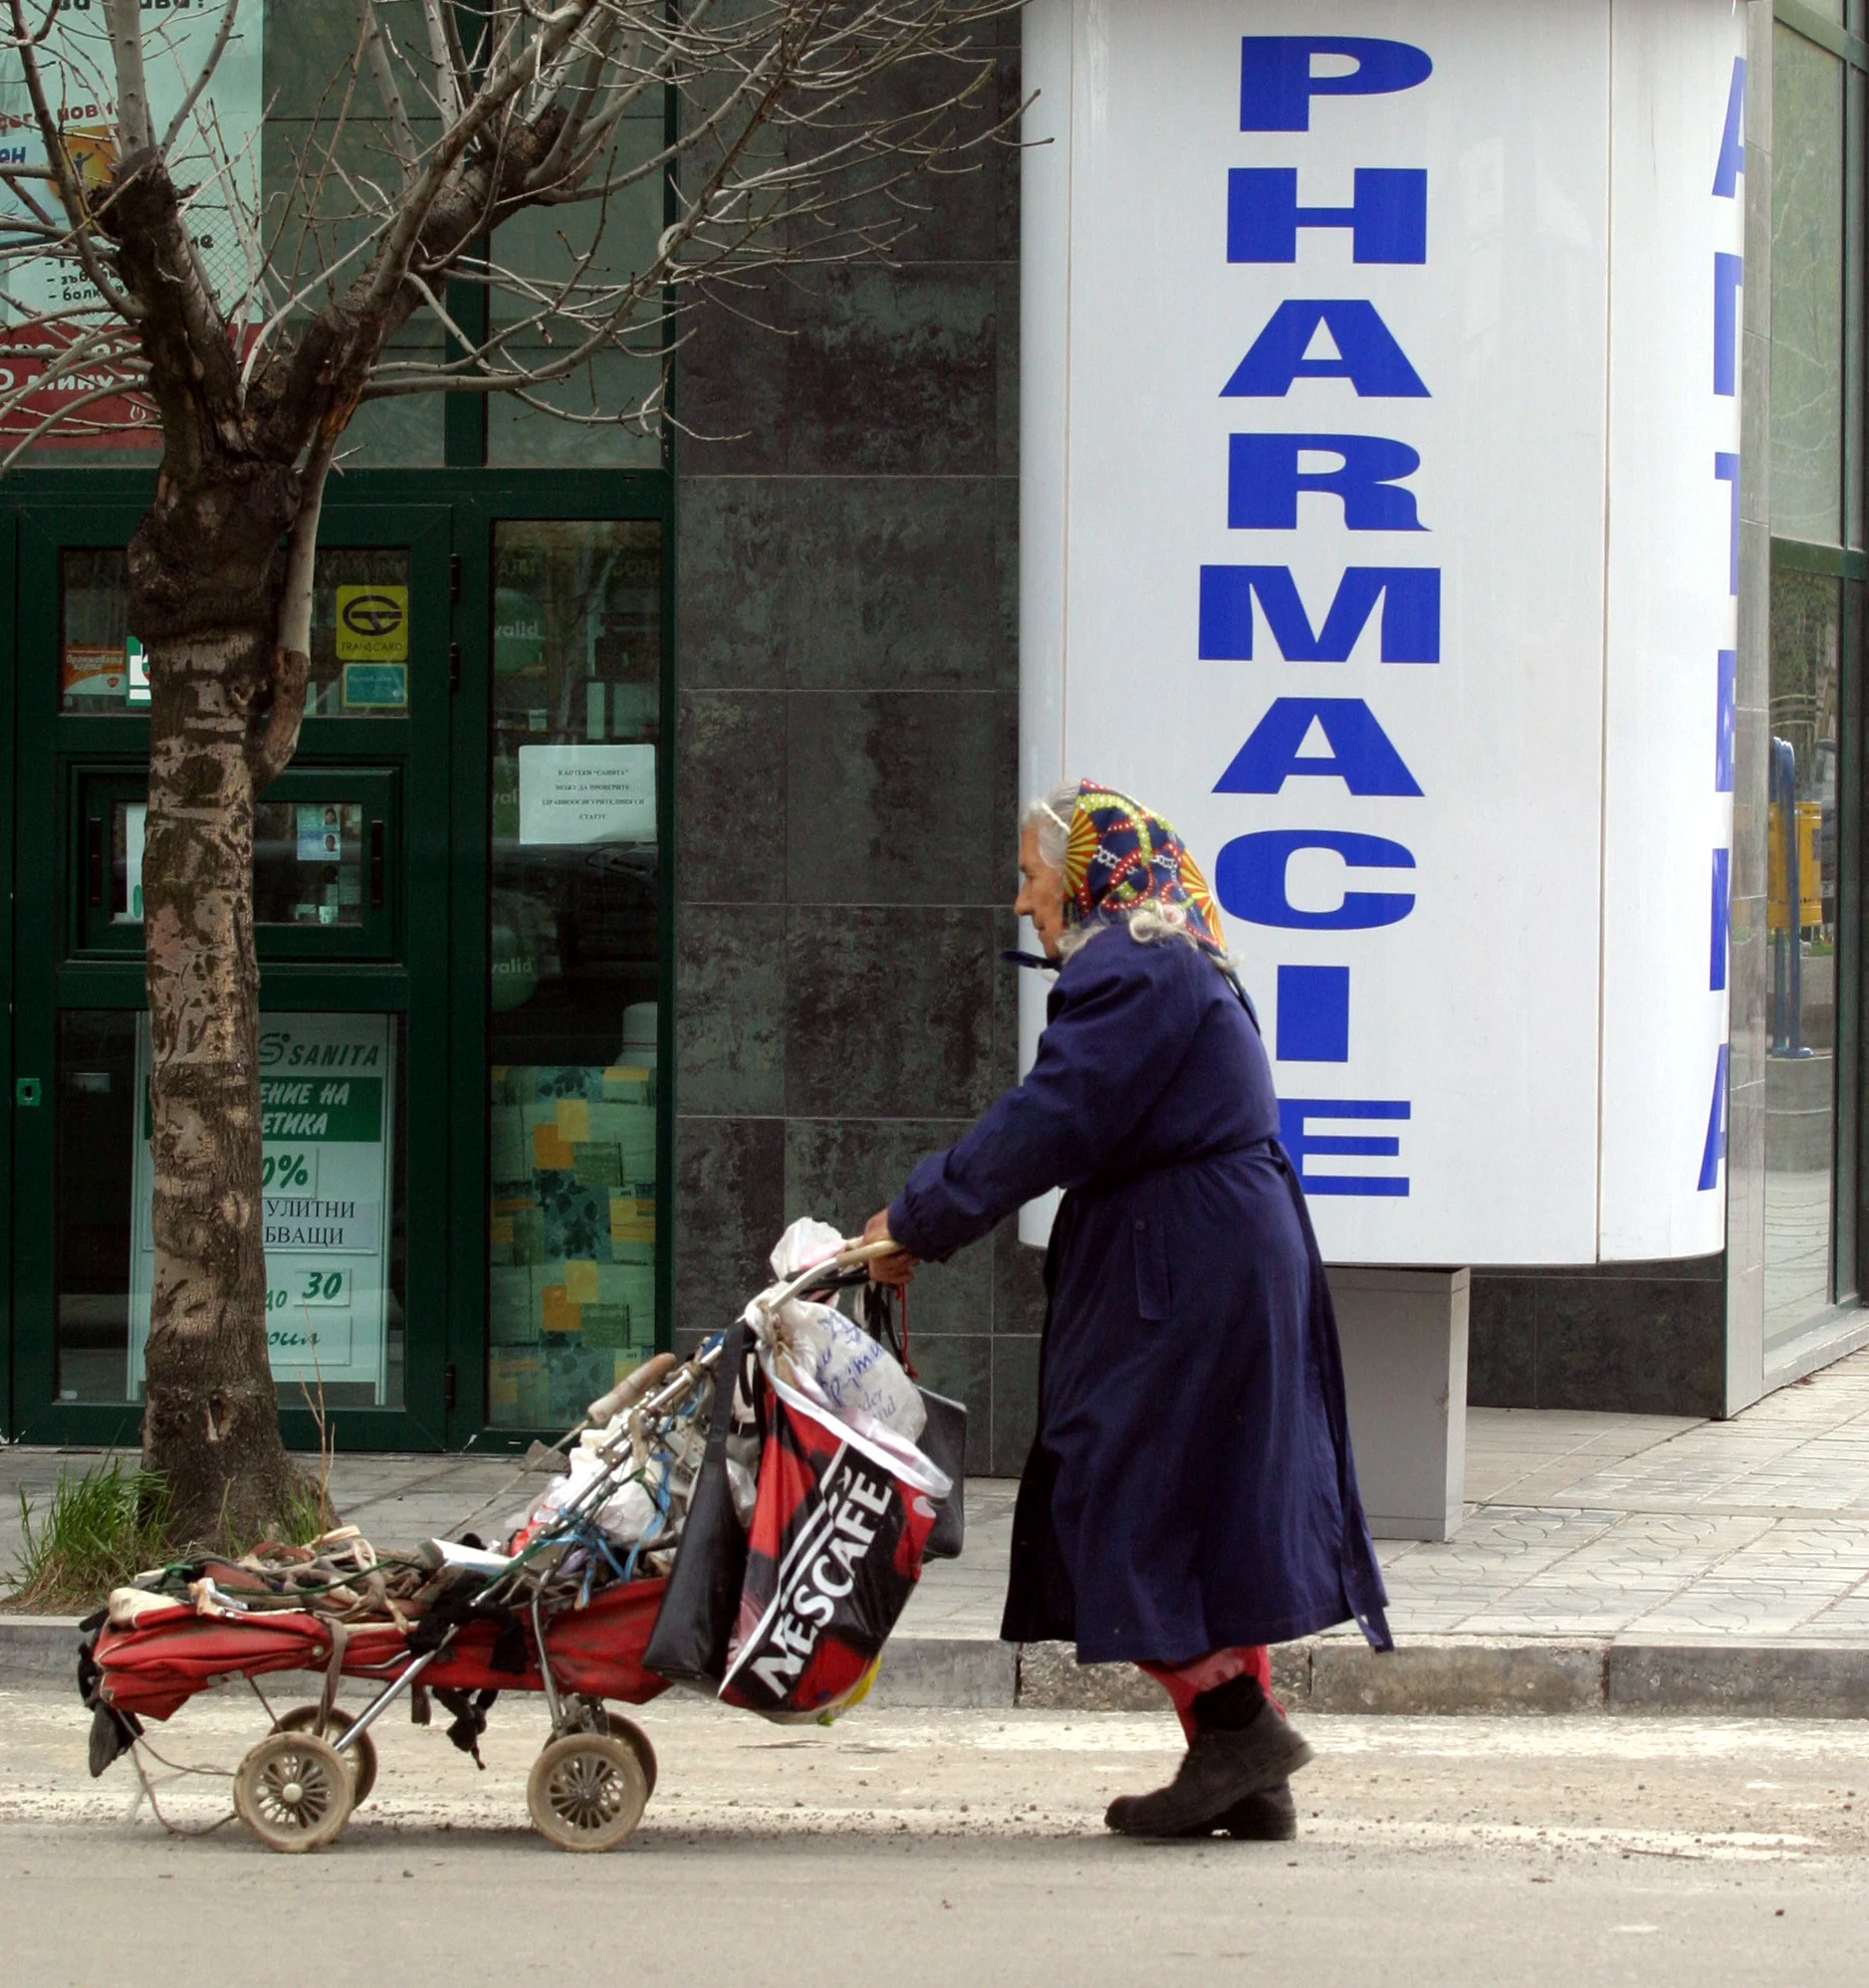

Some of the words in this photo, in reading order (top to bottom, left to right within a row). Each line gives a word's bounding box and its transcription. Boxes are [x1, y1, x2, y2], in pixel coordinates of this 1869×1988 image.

[1200, 37, 1441, 1196] PHARMACIE
[342, 641, 403, 652] TRANSCARD
[288, 1043, 380, 1066] SANITA
[320, 1081, 350, 1106] НА
[302, 1271, 343, 1300] 30
